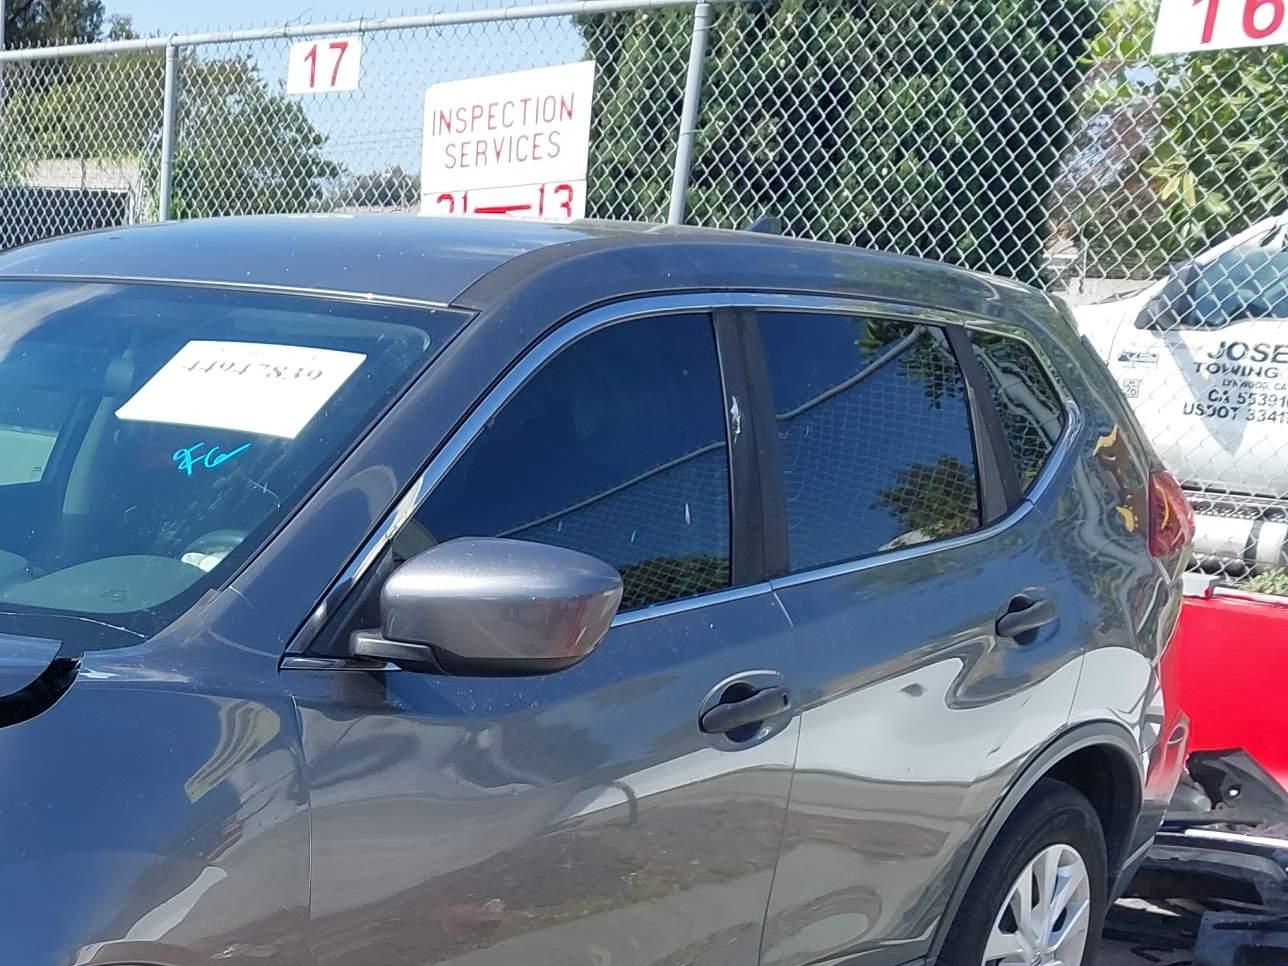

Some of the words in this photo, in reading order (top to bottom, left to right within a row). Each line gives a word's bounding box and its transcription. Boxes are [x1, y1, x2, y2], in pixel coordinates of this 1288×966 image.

[1192, 0, 1285, 44] 16
[303, 41, 349, 88] 17
[432, 93, 575, 137] INSPECTION
[444, 130, 561, 170] SERVICES
[1193, 361, 1280, 378] TOWING
[1182, 402, 1240, 420] USDOT
[1237, 392, 1288, 408] 55391
